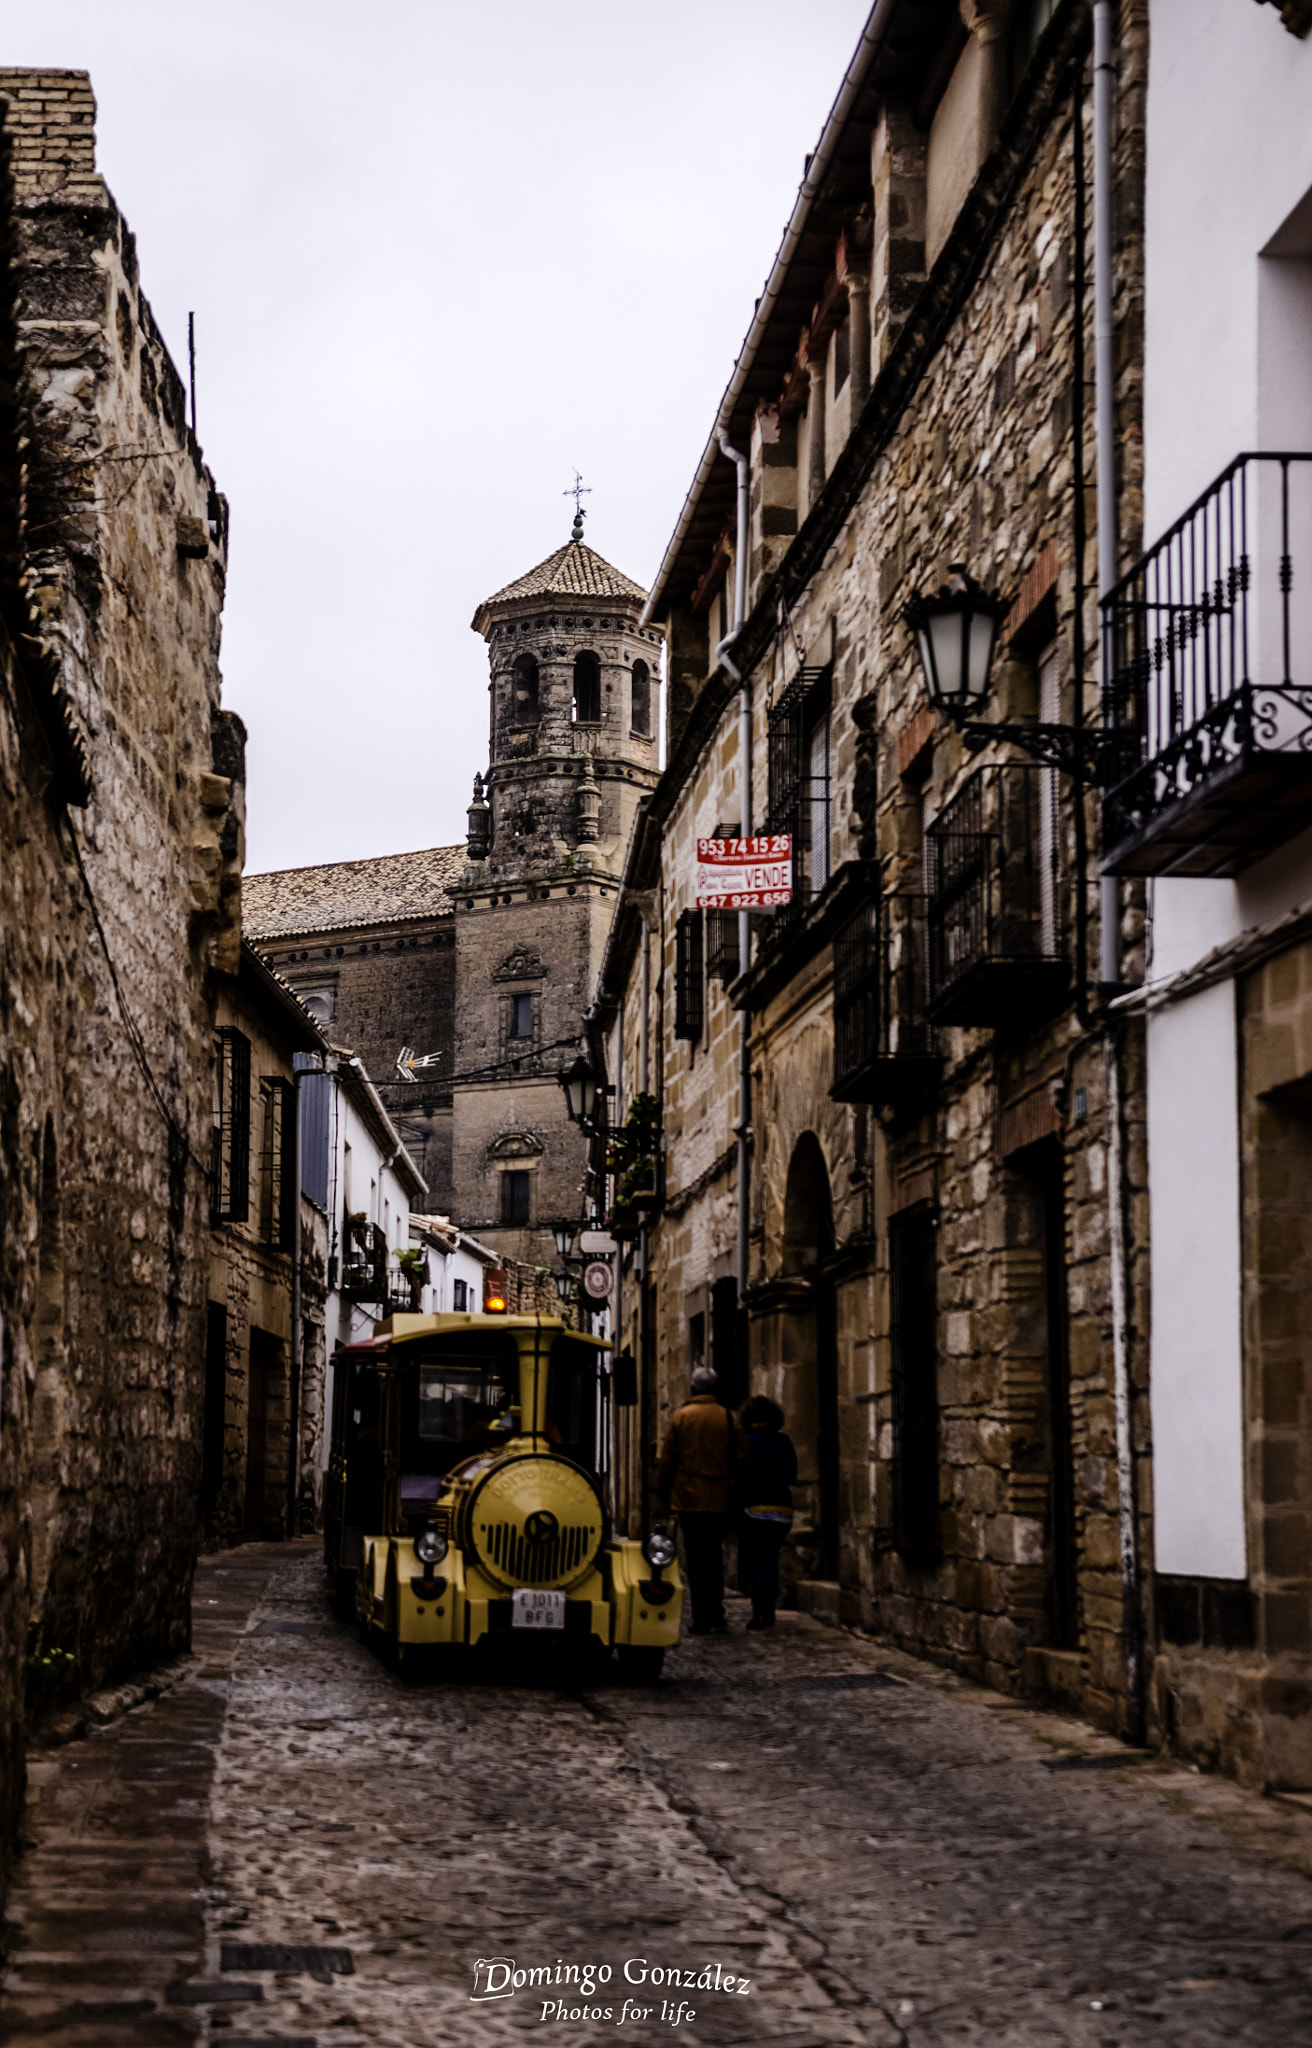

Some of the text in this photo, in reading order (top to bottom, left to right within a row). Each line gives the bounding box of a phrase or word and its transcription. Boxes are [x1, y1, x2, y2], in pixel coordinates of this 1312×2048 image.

[699, 834, 789, 855] 953 74 15 26
[745, 865, 788, 889] VENDE
[698, 891, 791, 908] 647 922 656
